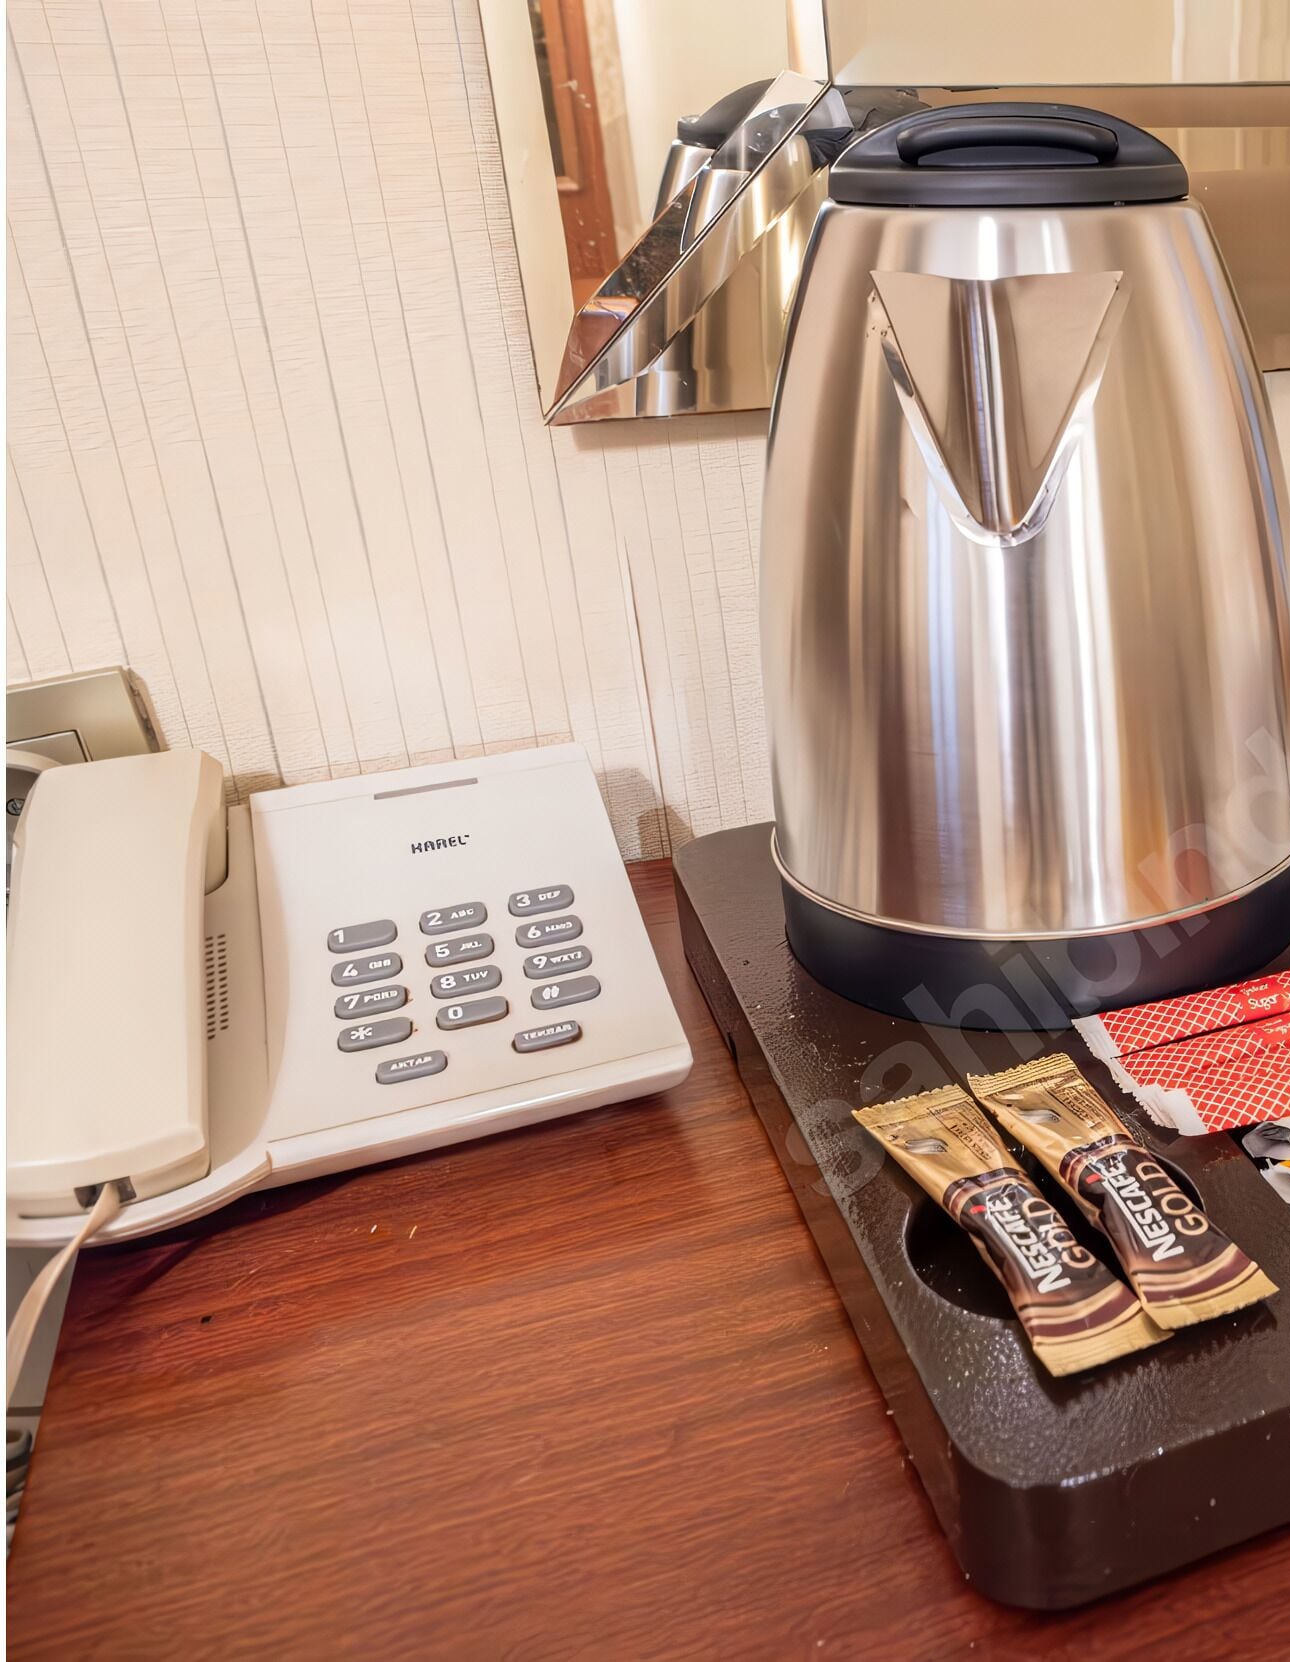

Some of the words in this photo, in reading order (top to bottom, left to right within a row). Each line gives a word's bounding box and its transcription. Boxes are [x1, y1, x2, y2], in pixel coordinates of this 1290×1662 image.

[516, 893, 531, 907] 3
[427, 912, 443, 926] 2
[450, 908, 475, 919] ABC
[333, 929, 345, 943] 1
[527, 925, 542, 939] 6
[435, 943, 450, 958] 5
[532, 955, 548, 969] 9
[342, 963, 359, 977] 4
[440, 975, 456, 989] 8
[343, 994, 361, 1010] 7
[447, 1006, 463, 1020] 0
[1135, 1160, 1210, 1237] GOLD
[1021, 1196, 1099, 1270] GOLD
